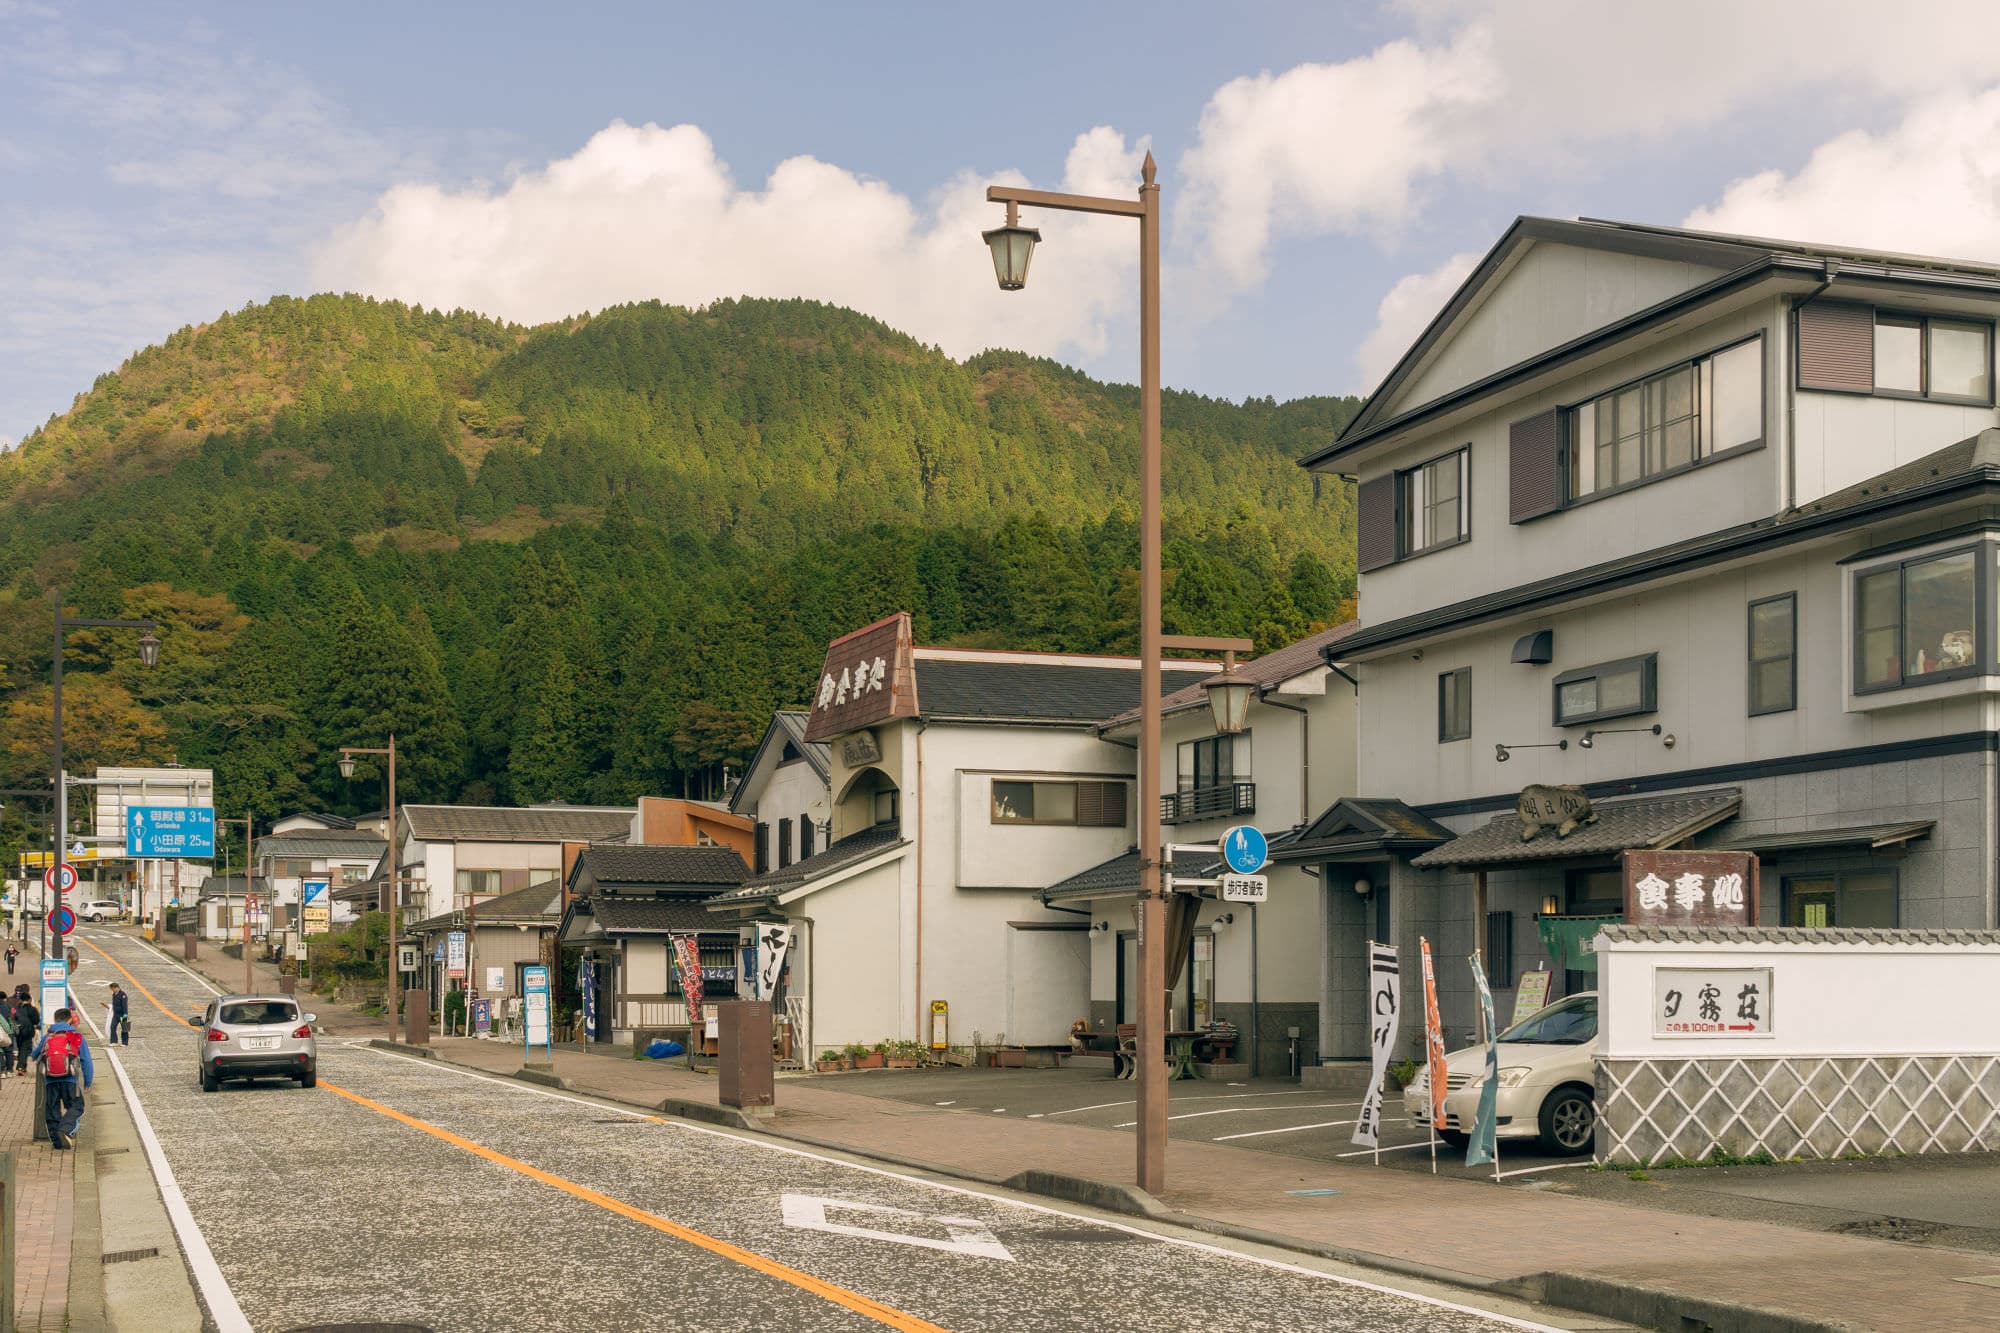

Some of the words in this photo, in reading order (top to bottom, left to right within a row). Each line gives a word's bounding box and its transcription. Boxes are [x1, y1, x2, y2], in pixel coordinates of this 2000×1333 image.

[150, 810, 186, 822] 御殿場
[150, 834, 186, 846] 小田原
[1227, 879, 1264, 896] 歩行者優先
[1635, 872, 1744, 911] 食事処
[1663, 983, 1760, 1023] 夕霧荘
